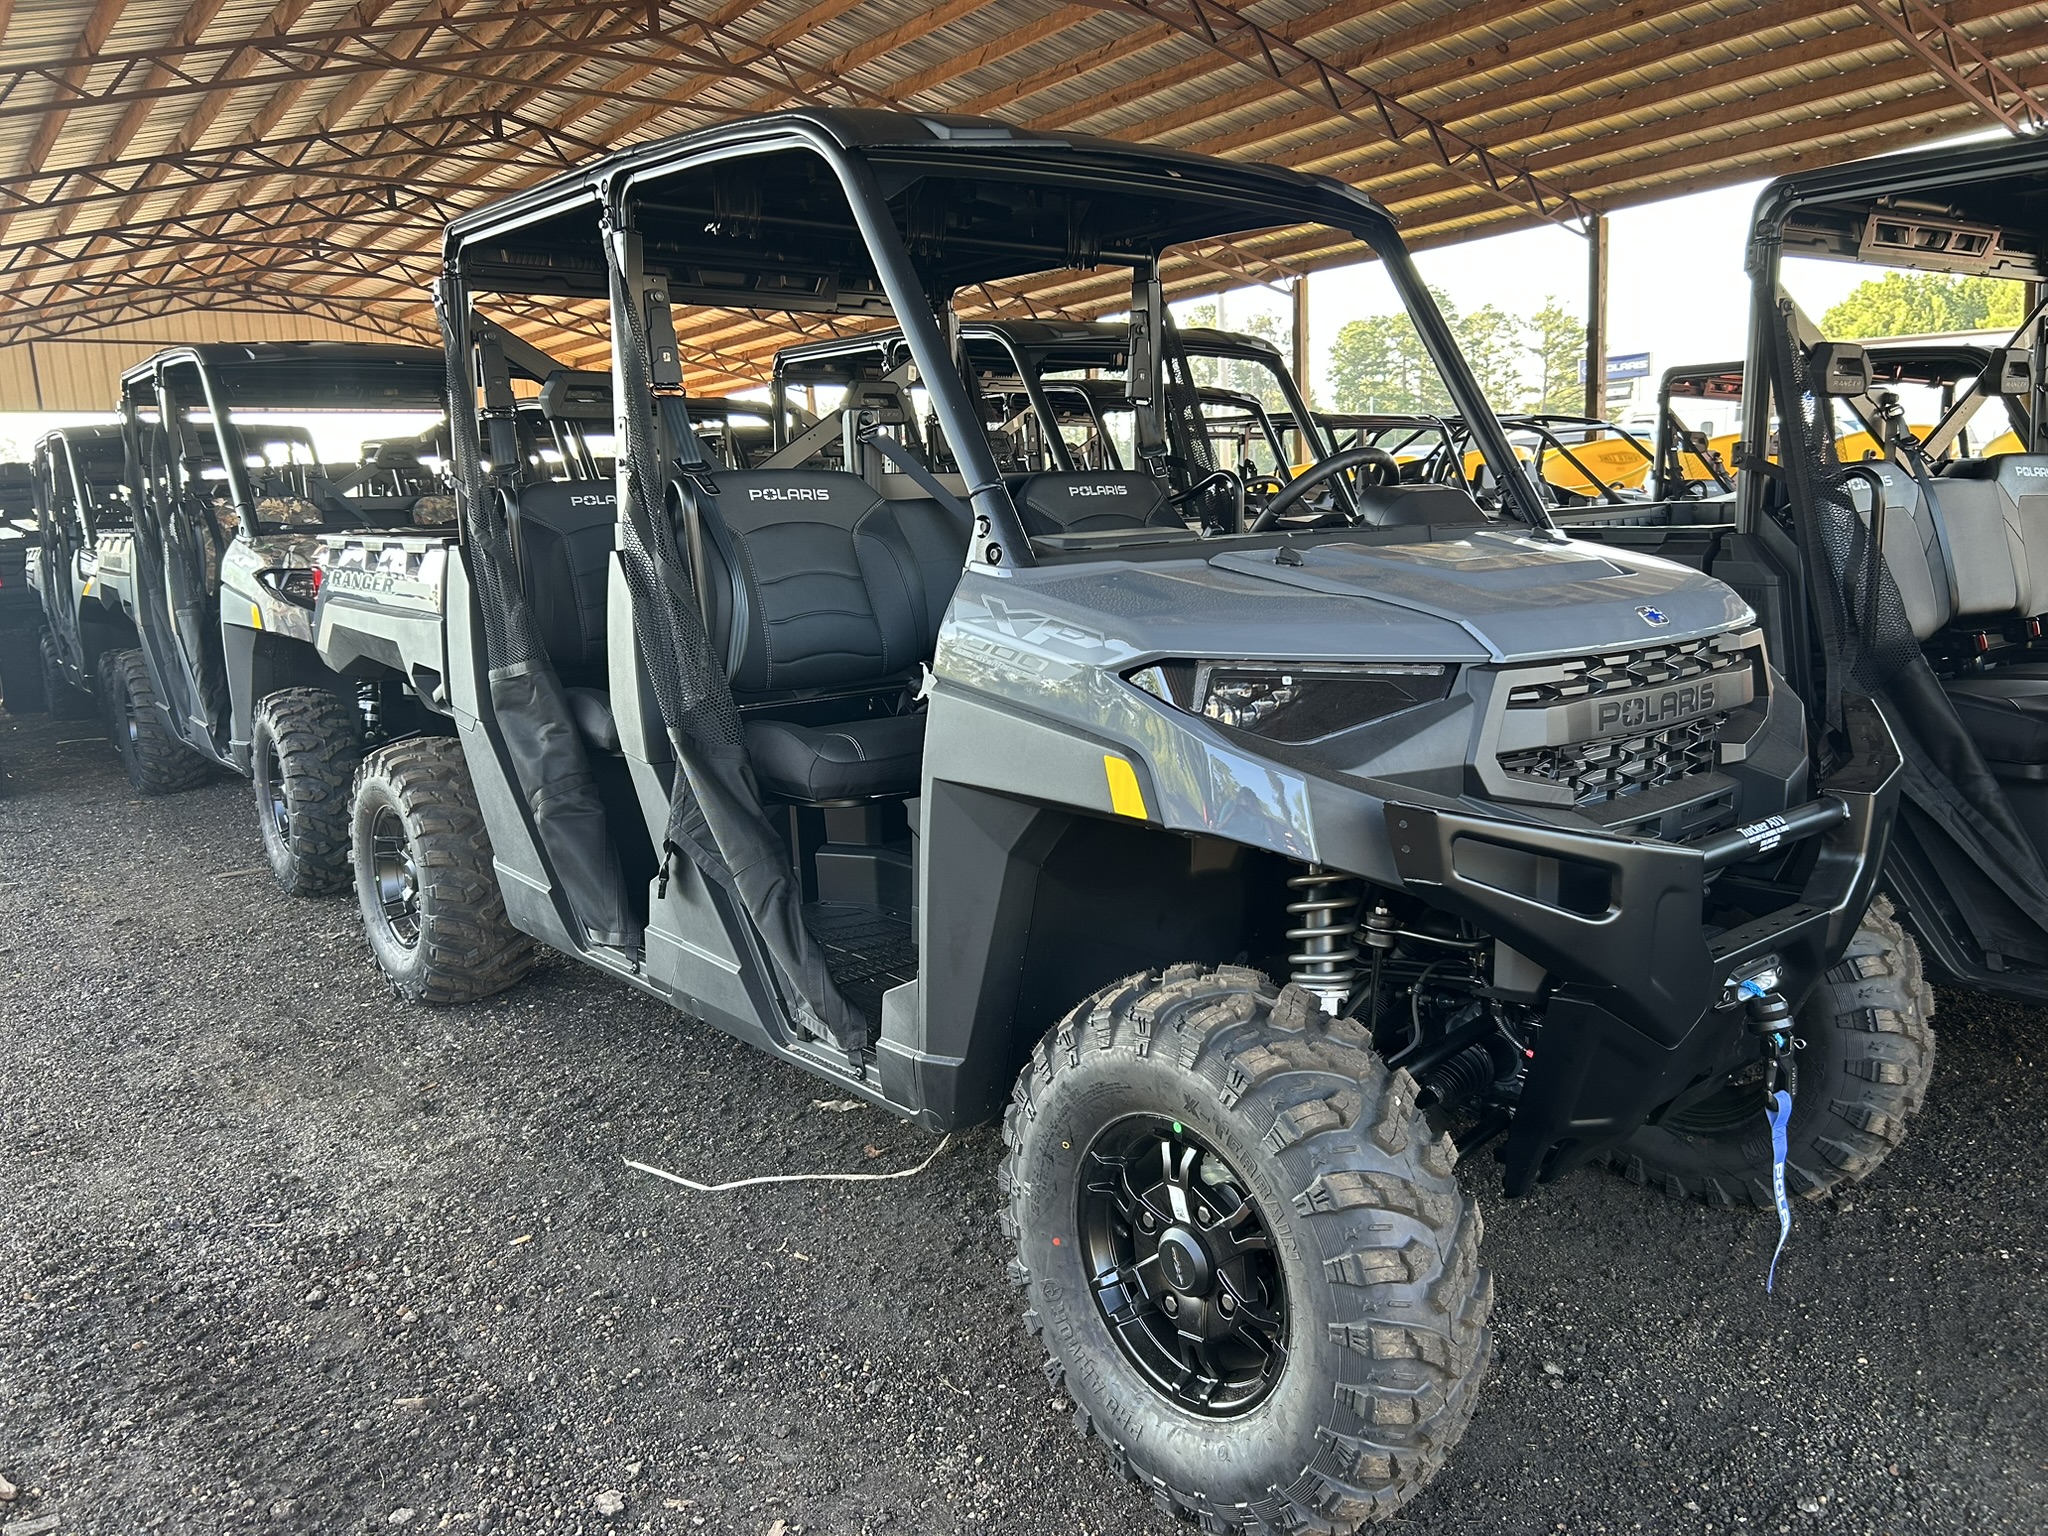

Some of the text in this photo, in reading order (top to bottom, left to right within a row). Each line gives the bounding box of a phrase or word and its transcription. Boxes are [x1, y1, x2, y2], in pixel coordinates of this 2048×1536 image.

[1606, 360, 1648, 373] OLARIS
[2015, 466, 2048, 478] POLAR
[1068, 485, 1128, 497] POLARIS
[1846, 474, 1894, 491] POLIS
[570, 494, 617, 507] POLA
[748, 488, 830, 501] POLARIS
[332, 570, 394, 594] RANGER
[962, 593, 1105, 650] XP
[954, 630, 1050, 674] 1000
[1598, 682, 1716, 732] POLARIS
[1736, 822, 1769, 838] Tucker
[1765, 815, 1786, 829] ATV
[1050, 1300, 1145, 1442] PRO ARMOR
